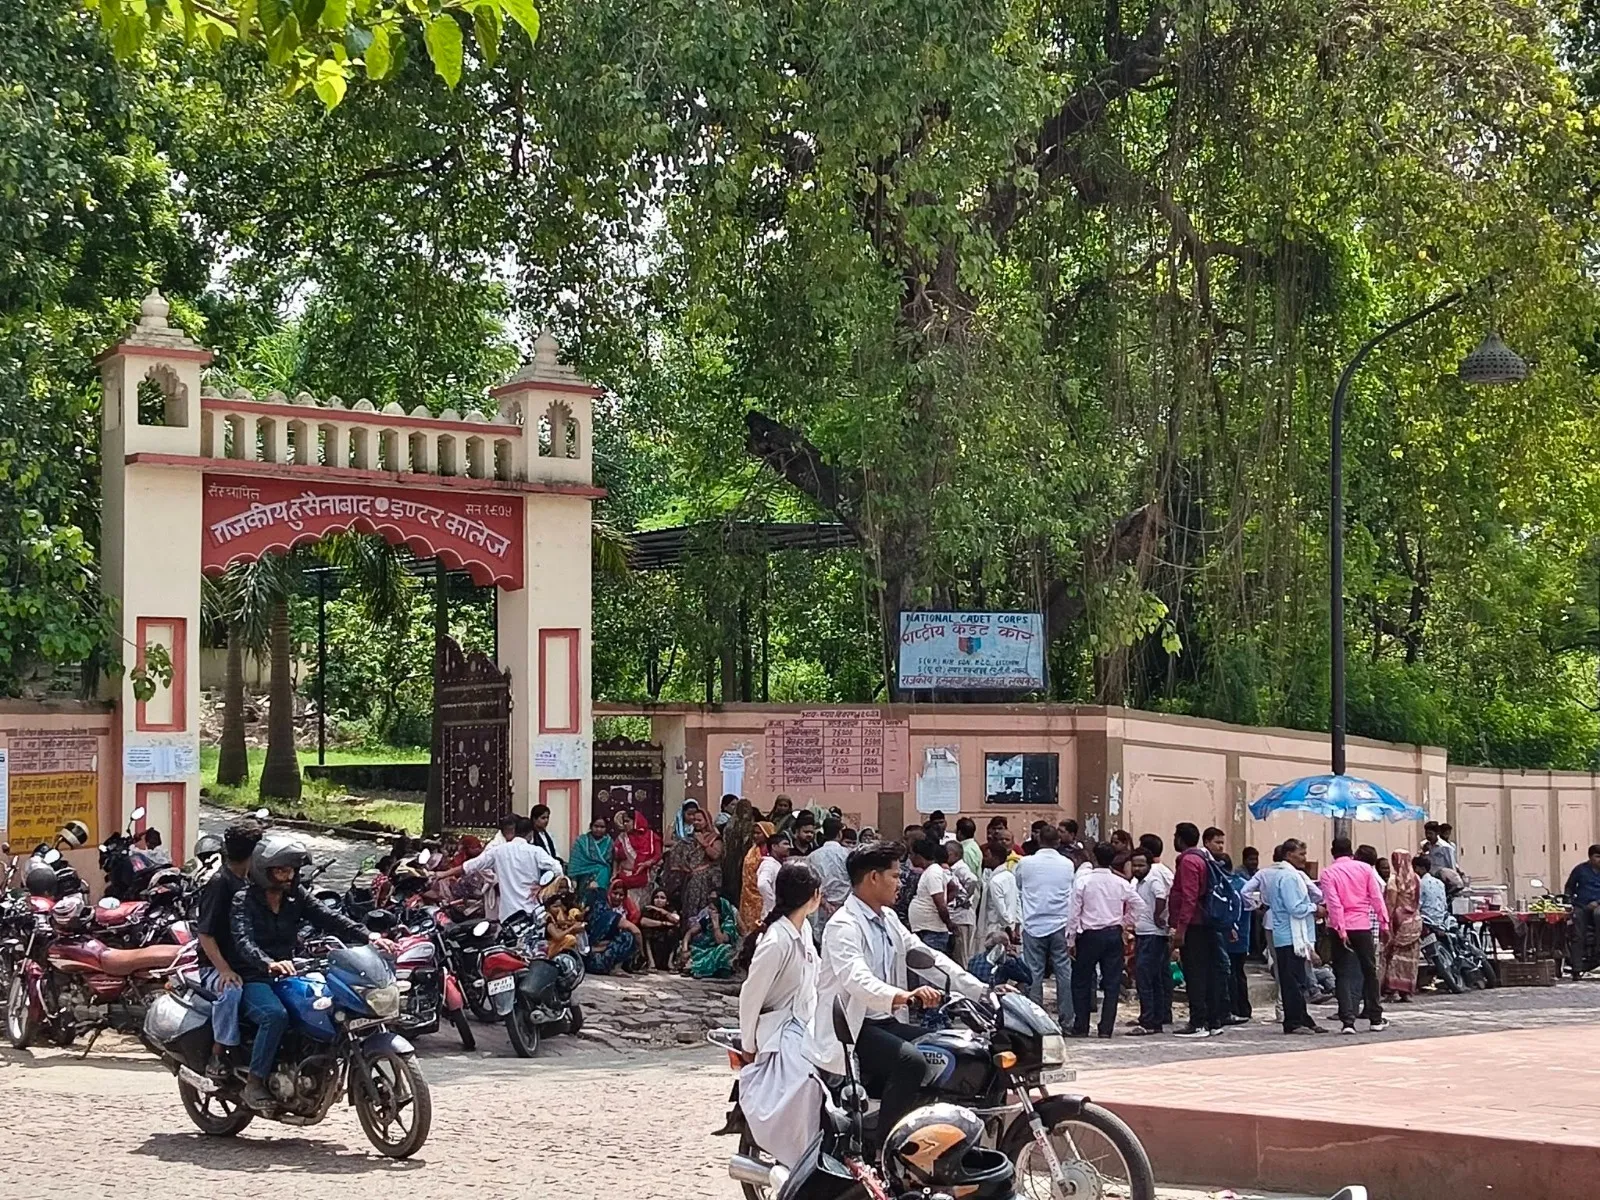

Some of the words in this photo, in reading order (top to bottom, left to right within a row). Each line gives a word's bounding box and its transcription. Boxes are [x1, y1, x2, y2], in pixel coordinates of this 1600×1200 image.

[210, 500, 288, 544] राजकीय
[390, 498, 445, 529] इण्टर
[445, 512, 512, 558] कालेज
[906, 613, 954, 623] NATIONAL
[960, 614, 991, 624] CADET
[997, 615, 1029, 624] CORPS
